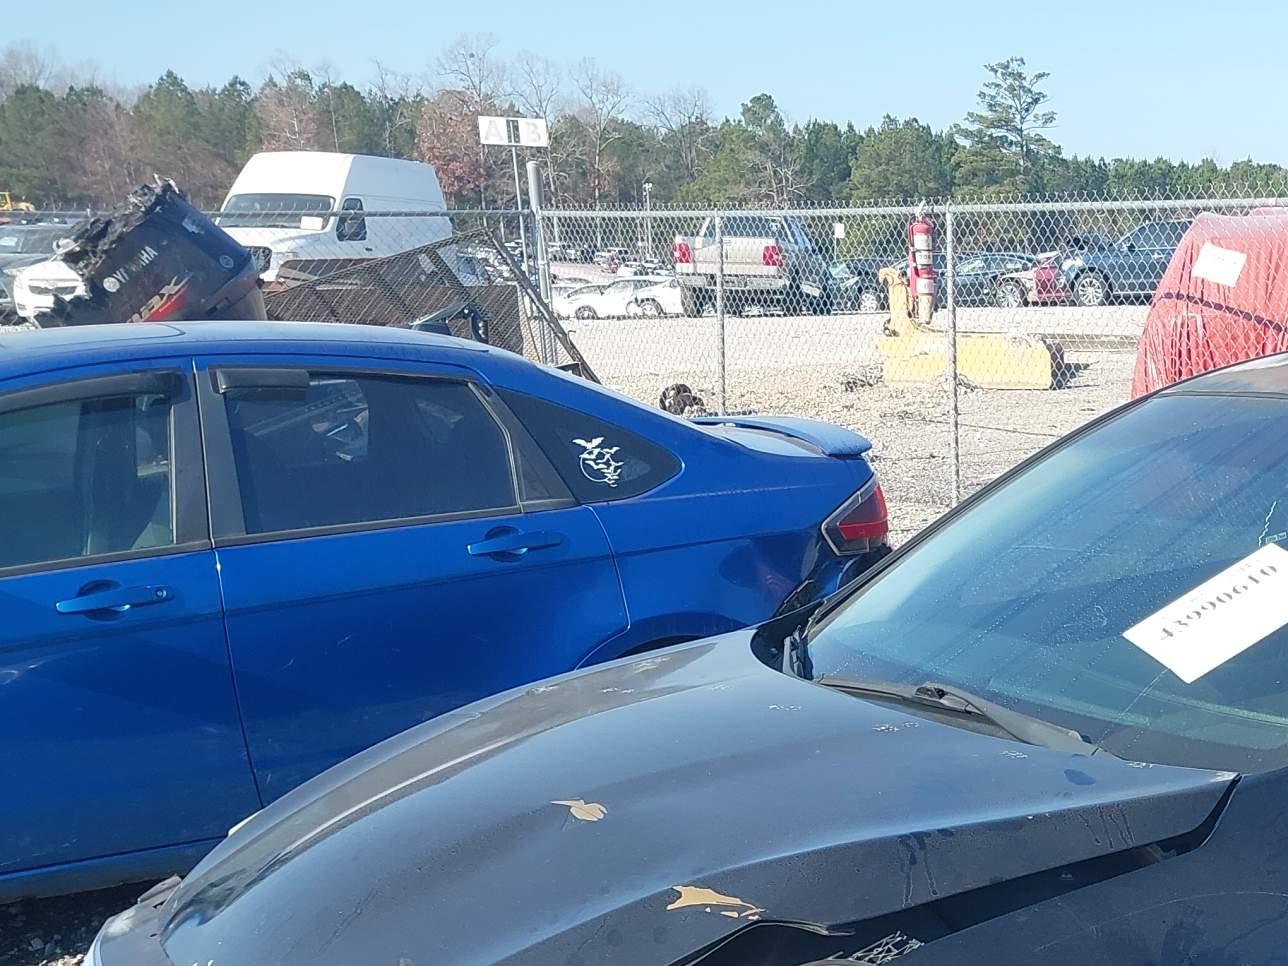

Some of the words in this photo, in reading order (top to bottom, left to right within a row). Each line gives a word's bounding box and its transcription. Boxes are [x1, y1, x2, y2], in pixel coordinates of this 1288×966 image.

[485, 119, 504, 141] A
[525, 121, 542, 143] B
[112, 246, 159, 283] YAAHA
[1160, 565, 1277, 640] 43990610
